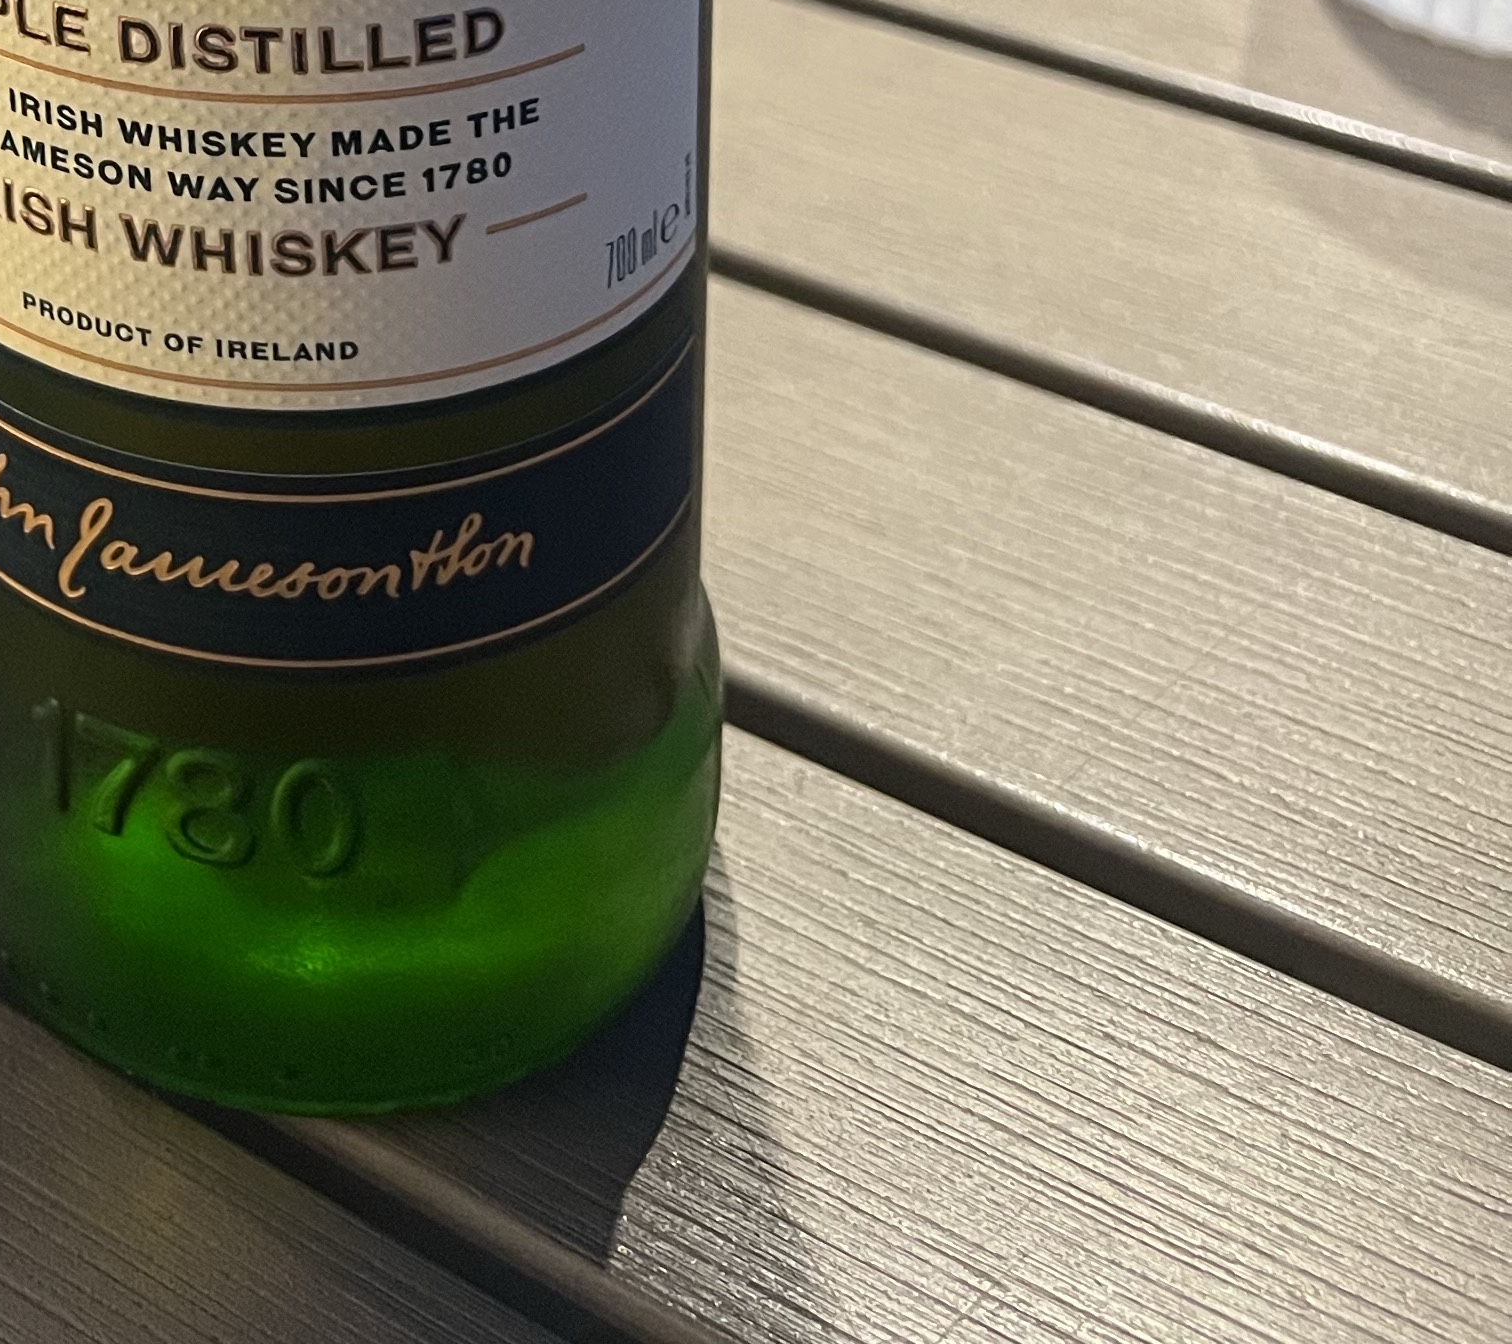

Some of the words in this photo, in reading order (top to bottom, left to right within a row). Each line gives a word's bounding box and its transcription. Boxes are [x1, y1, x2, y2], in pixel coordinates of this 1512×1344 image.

[117, 6, 506, 76] DISTILLED
[8, 86, 104, 139] IRISH
[117, 116, 317, 159] WHISKEY
[331, 119, 452, 158] MADE
[466, 96, 541, 139] THE
[166, 169, 260, 204] WAY
[273, 170, 407, 205] SINCE
[421, 151, 513, 194] 1780
[119, 211, 468, 278] WHISKEY
[605, 226, 637, 290] 700
[22, 290, 152, 348] PRODUCT
[162, 331, 204, 355] OF
[214, 340, 360, 363] IRELAND
[57, 497, 401, 601] Jameson
[31, 696, 363, 882] 1780
